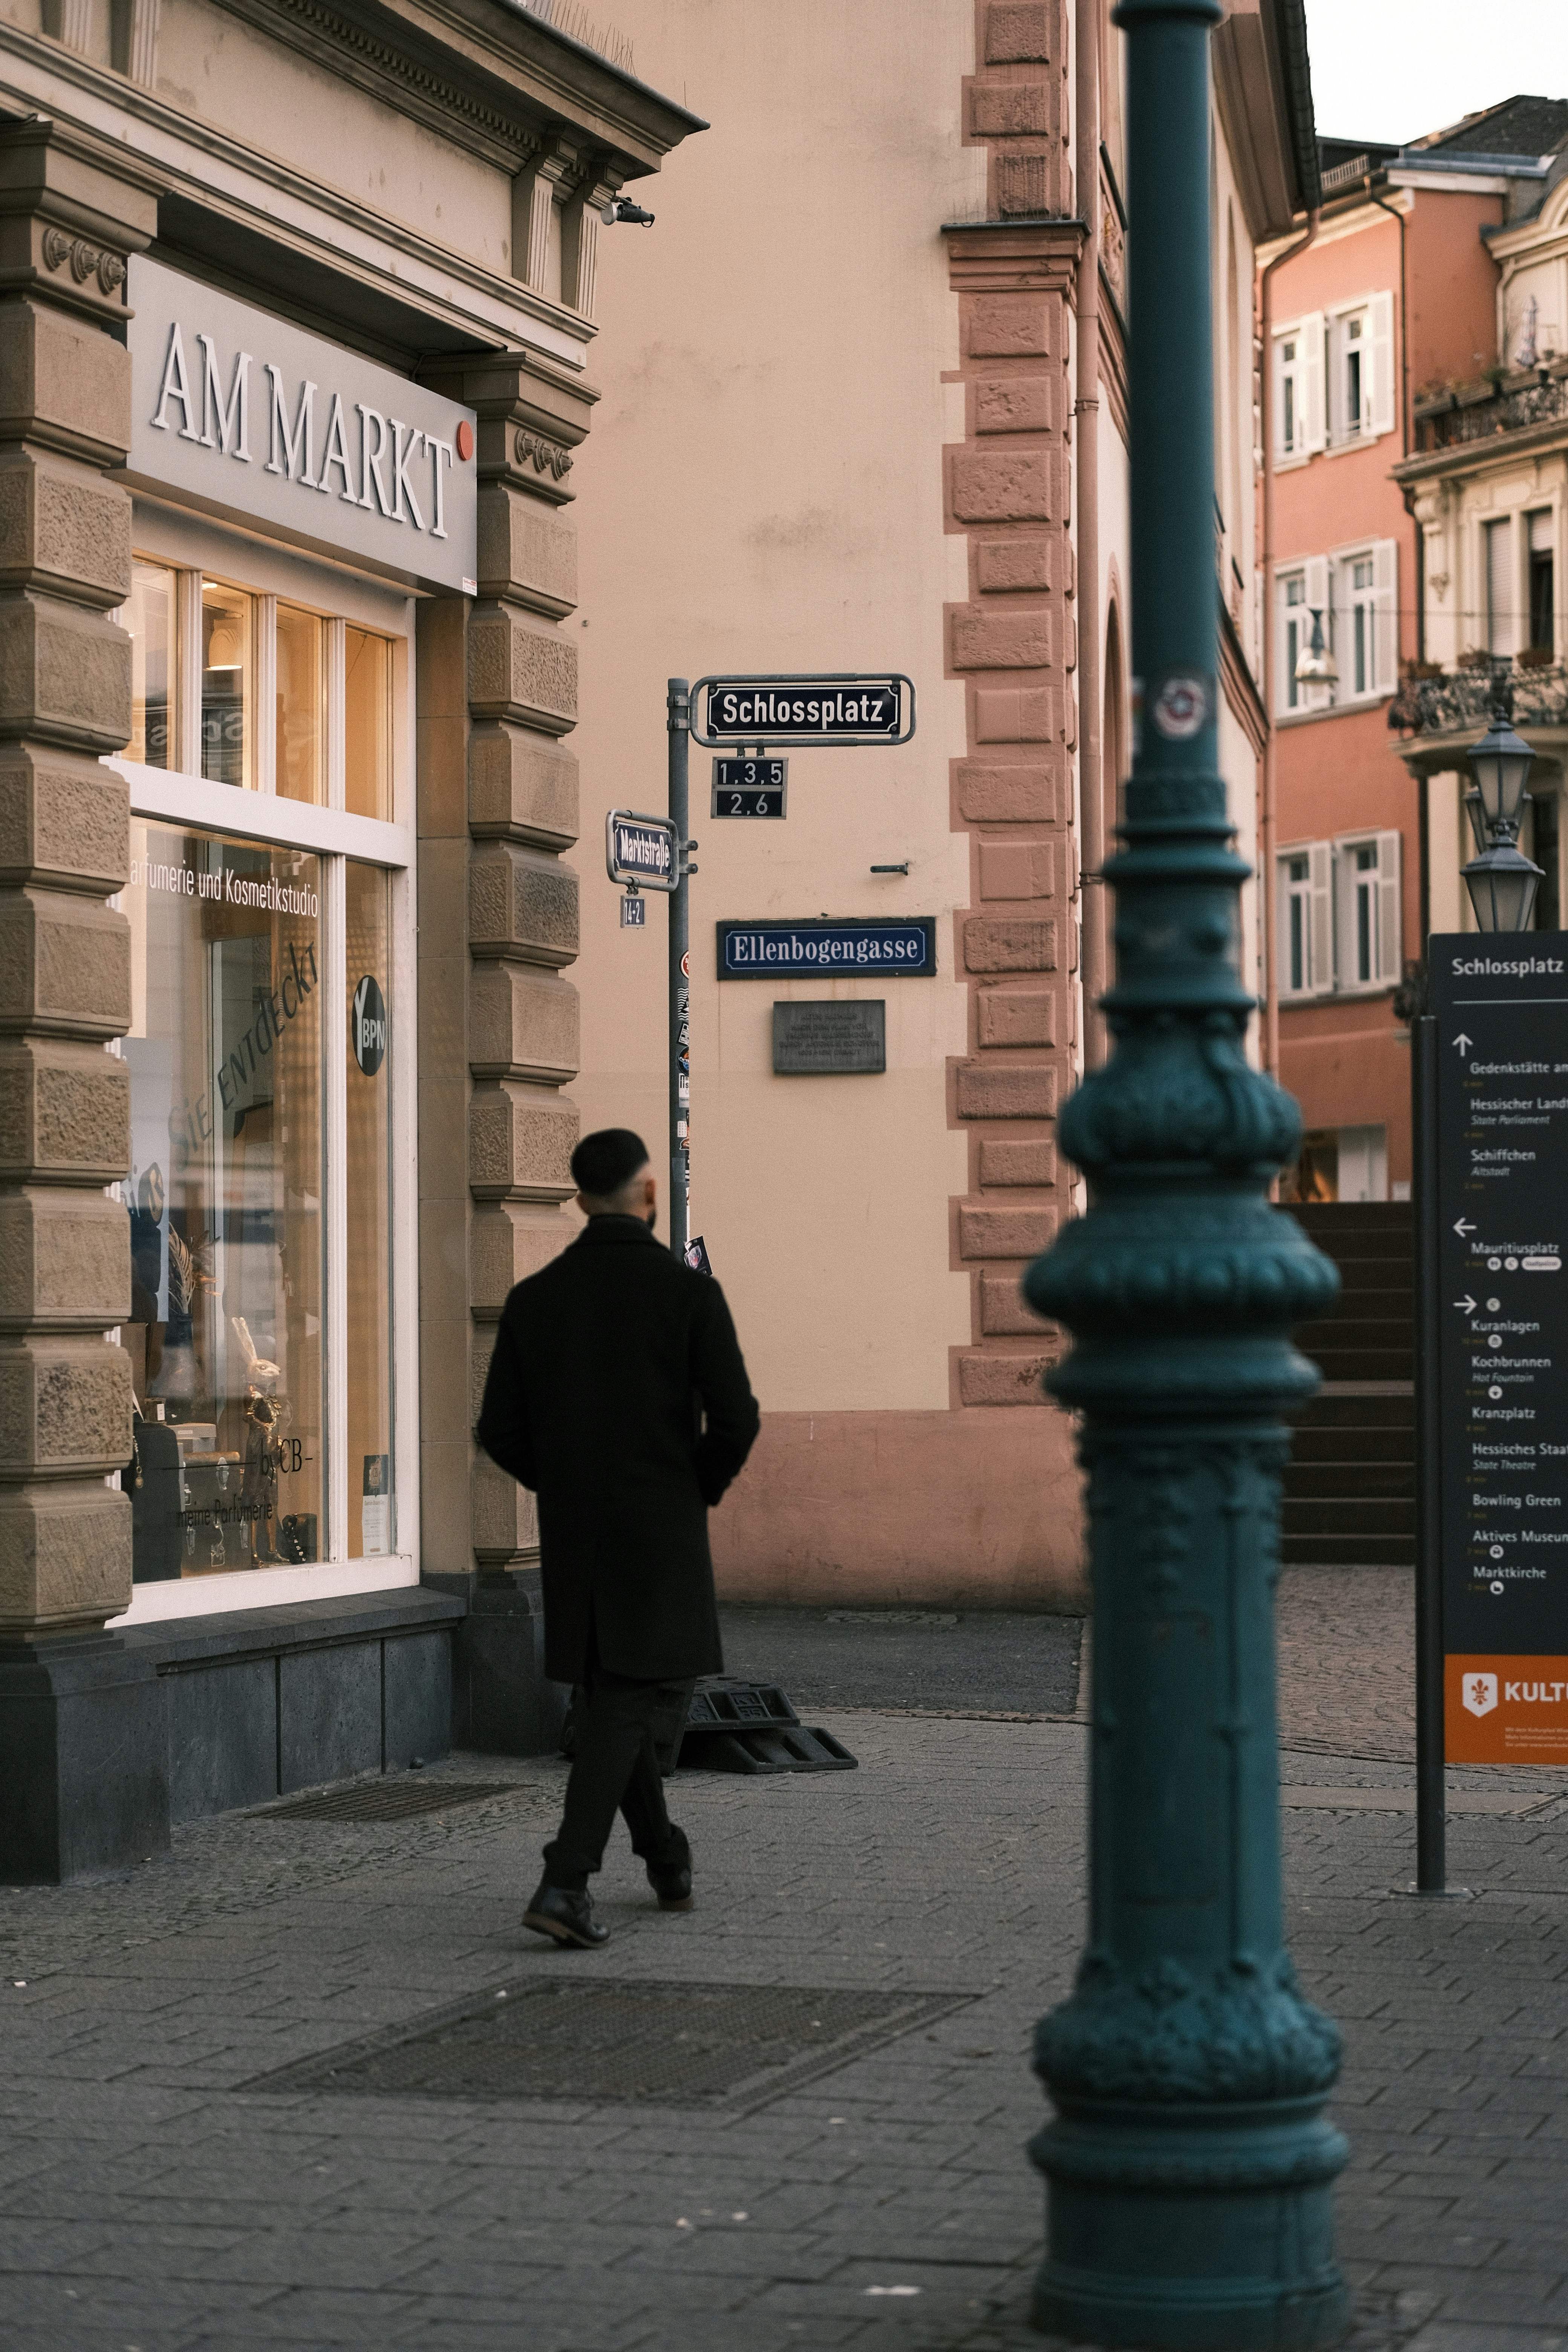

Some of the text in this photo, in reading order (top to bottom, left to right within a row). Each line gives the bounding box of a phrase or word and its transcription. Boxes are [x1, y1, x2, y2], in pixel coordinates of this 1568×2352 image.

[151, 322, 453, 539] AM MARKT
[723, 694, 883, 730] Schlossplatz
[731, 793, 768, 815] 2,6
[620, 828, 670, 874] Marktstraße
[129, 853, 318, 917] arfumerie und Kosmetikstudio
[733, 935, 918, 964] Ellenbogengasse
[1452, 957, 1563, 978] Schlossplatz
[1470, 1062, 1550, 1074] Gedenkstätte
[1470, 1097, 1533, 1110] Hessischer
[1498, 1114, 1550, 1125] Parliament
[1470, 1148, 1536, 1162] Schiffchen
[1471, 1242, 1559, 1256] Mauritiusplatz
[1472, 1319, 1540, 1335] Kuranlagen
[1472, 1356, 1551, 1368] Kochbrunnen
[1491, 1372, 1534, 1383] Fountain
[1472, 1407, 1536, 1422] Kranzplatz
[279, 1438, 302, 1474] CB
[1472, 1443, 1536, 1455] Hessisches
[1472, 1460, 1537, 1470] State Theatre
[214, 1493, 273, 1524] Parfümerie
[1473, 1494, 1561, 1509] Bowling Green
[1473, 1530, 1517, 1542] Aktives
[1473, 1566, 1547, 1578] Marktkirche
